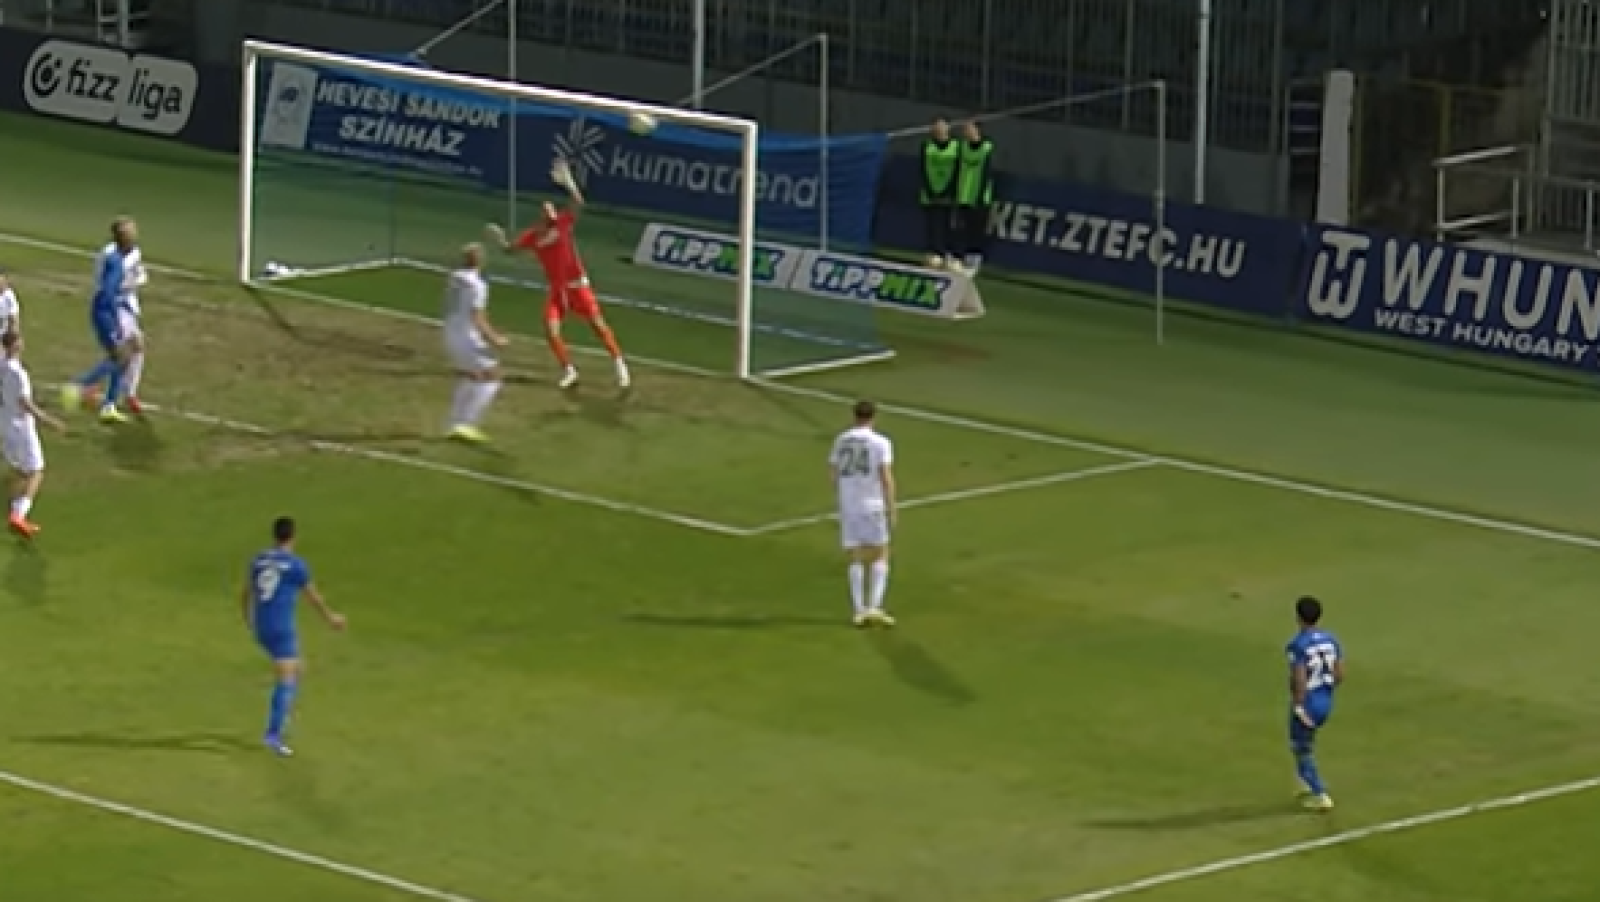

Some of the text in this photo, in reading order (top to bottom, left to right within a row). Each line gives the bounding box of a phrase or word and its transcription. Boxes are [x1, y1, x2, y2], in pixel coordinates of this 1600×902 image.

[65, 57, 183, 120] fizz liga
[317, 80, 401, 113] HEVESI
[1374, 308, 1447, 337] WEST
[1452, 322, 1590, 363] HUNGARY
[838, 446, 871, 479] 24
[256, 568, 281, 602] 9
